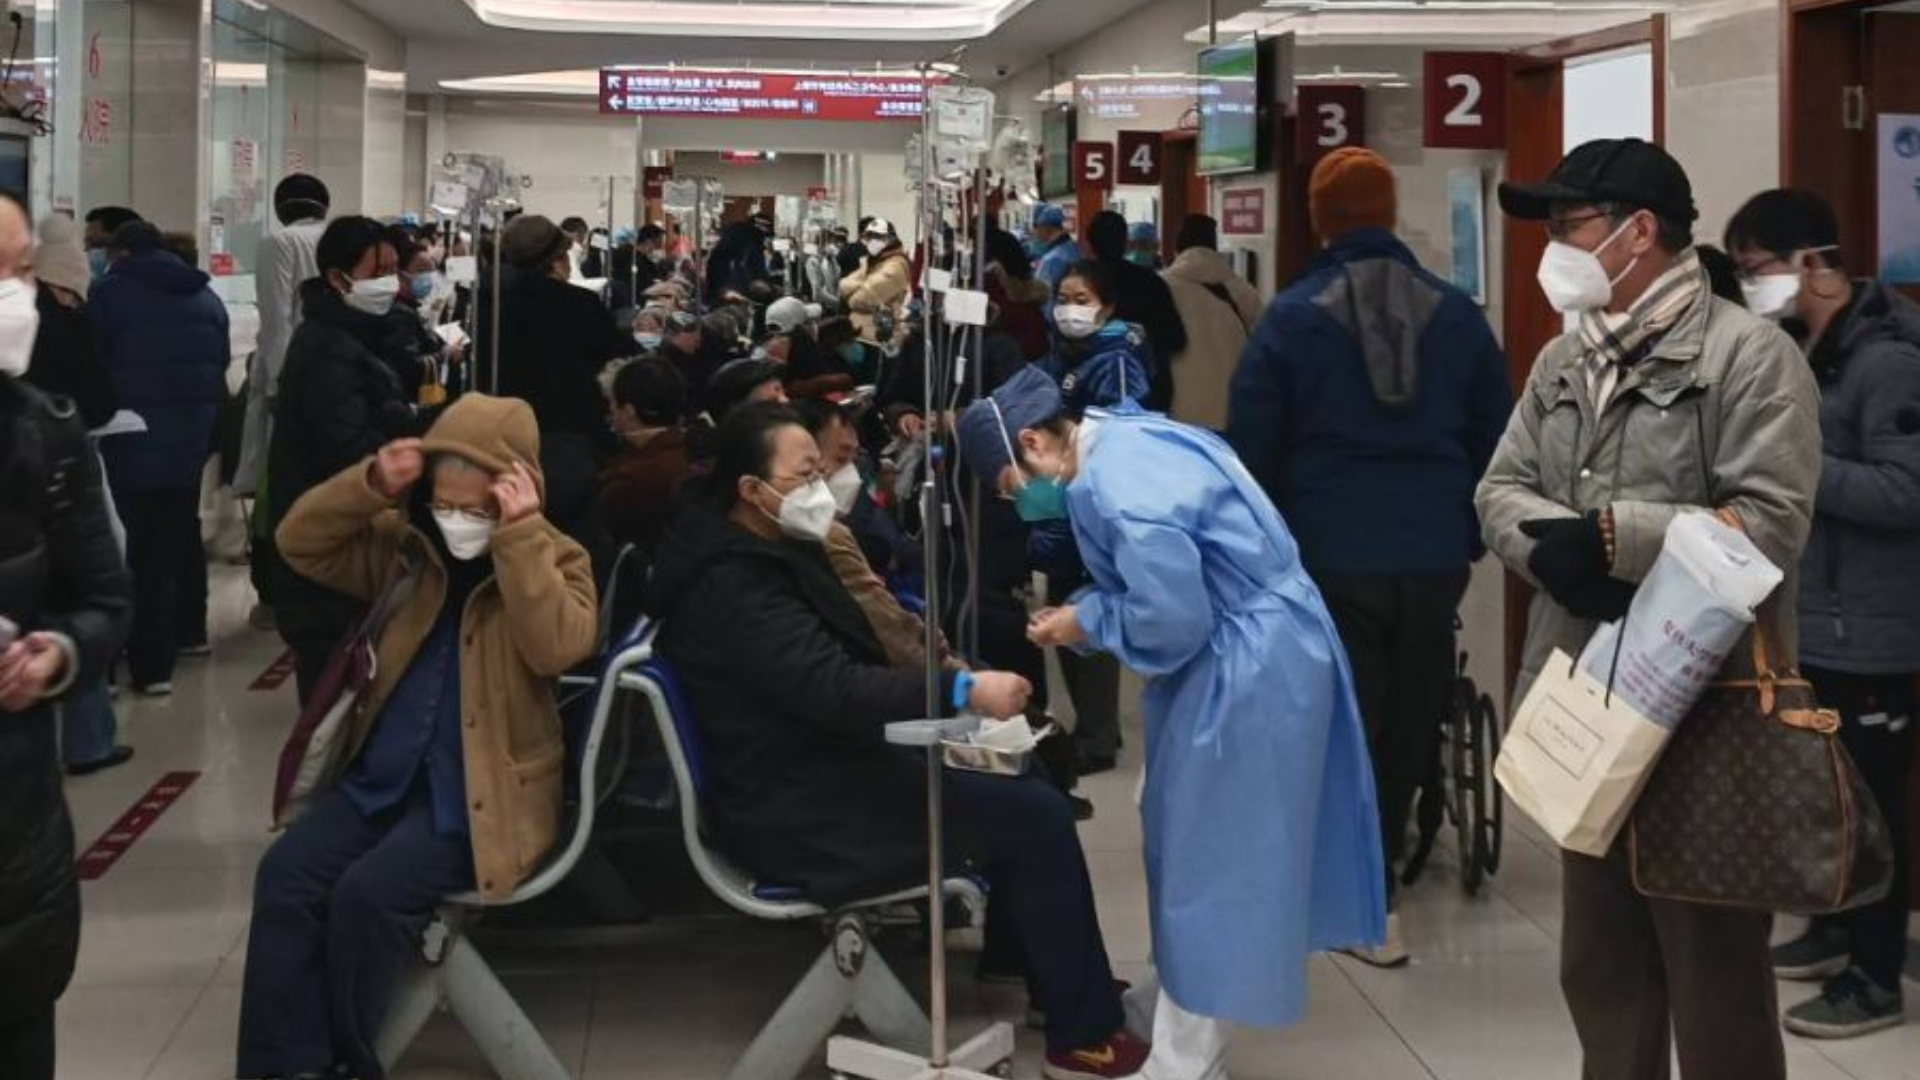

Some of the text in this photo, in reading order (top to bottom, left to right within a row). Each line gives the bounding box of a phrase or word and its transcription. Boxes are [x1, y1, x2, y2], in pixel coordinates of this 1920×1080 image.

[88, 29, 101, 79] 6
[1444, 74, 1483, 126] 2
[1317, 102, 1348, 147] 3
[1084, 152, 1105, 180] 5
[1128, 143, 1154, 175] 4
